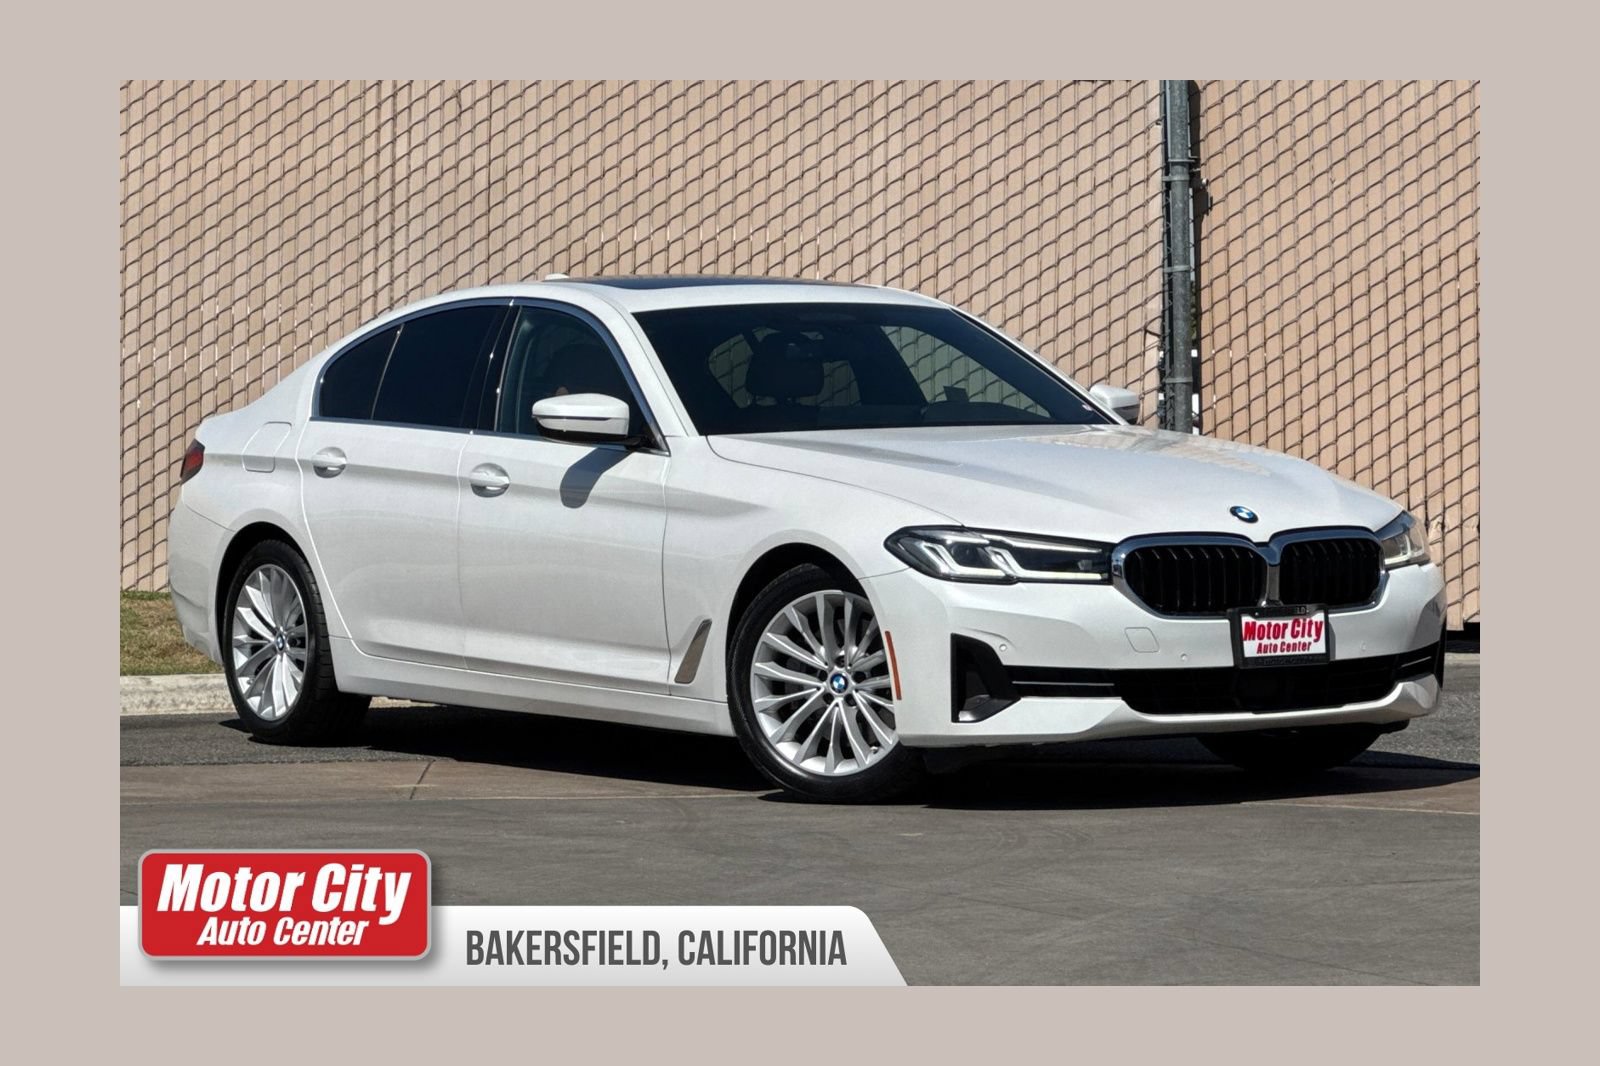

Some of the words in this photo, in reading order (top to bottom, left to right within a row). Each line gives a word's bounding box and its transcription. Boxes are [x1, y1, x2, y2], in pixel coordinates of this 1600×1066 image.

[1243, 621, 1289, 641] Motor
[1290, 617, 1324, 643] City
[1256, 642, 1278, 654] Auto
[1279, 641, 1312, 653] Center
